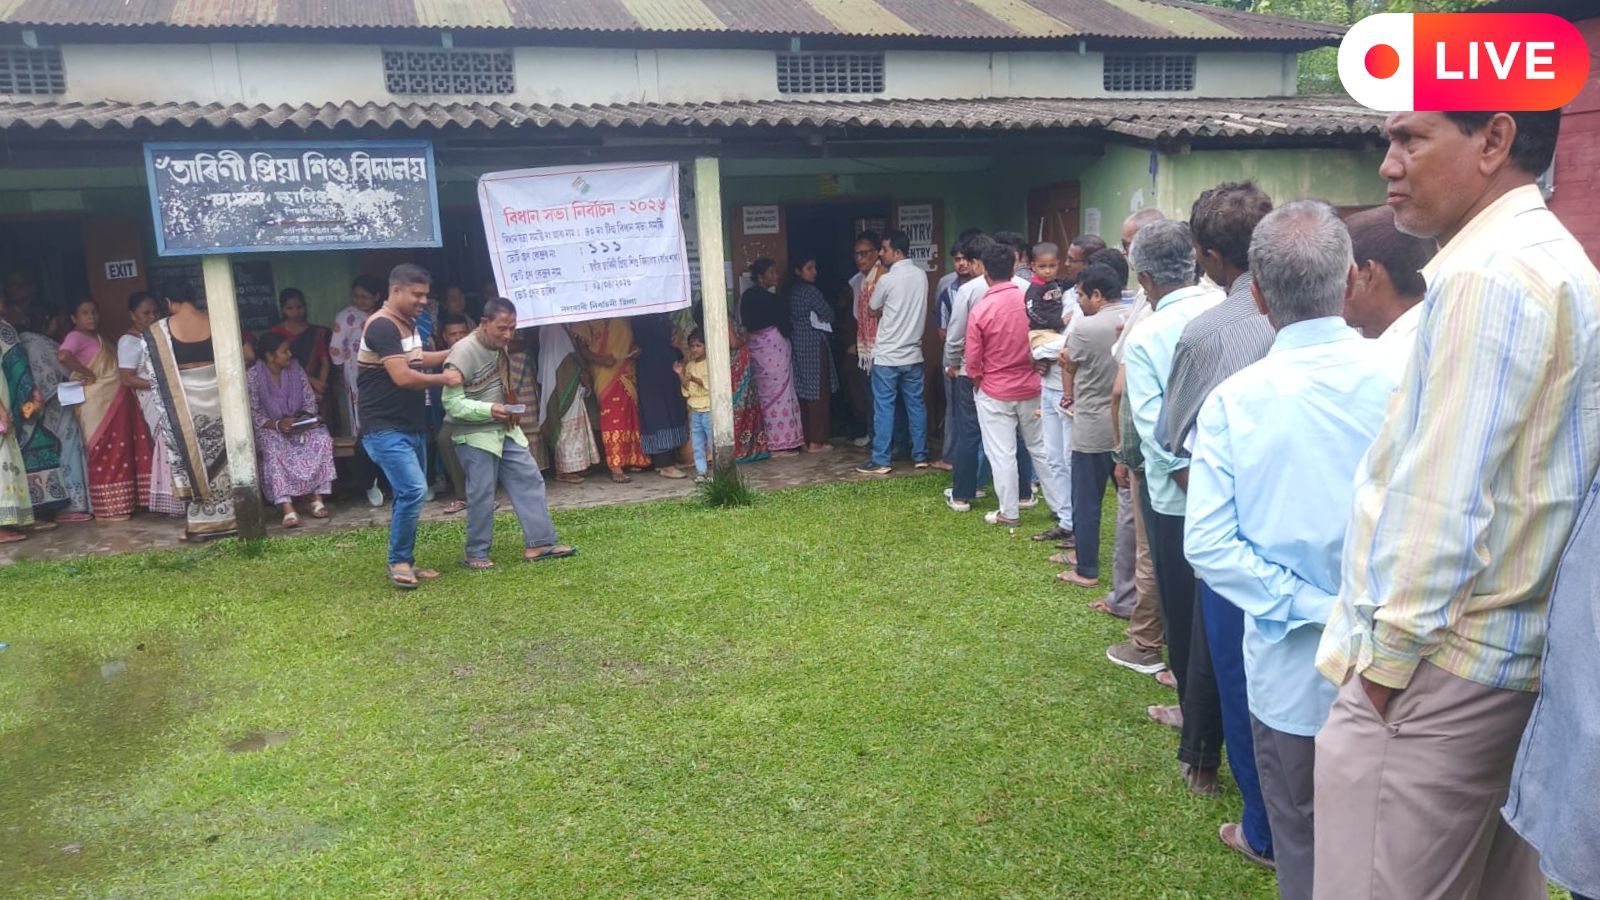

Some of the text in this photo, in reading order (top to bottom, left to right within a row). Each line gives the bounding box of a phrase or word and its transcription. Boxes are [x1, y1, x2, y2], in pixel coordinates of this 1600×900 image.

[303, 151, 349, 184] শিশু
[503, 206, 540, 227] বিধান
[544, 206, 568, 221] সভা
[572, 200, 616, 220] নিৰ্বাচন
[629, 197, 667, 215] ২০২৬
[109, 263, 133, 278] EXIT
